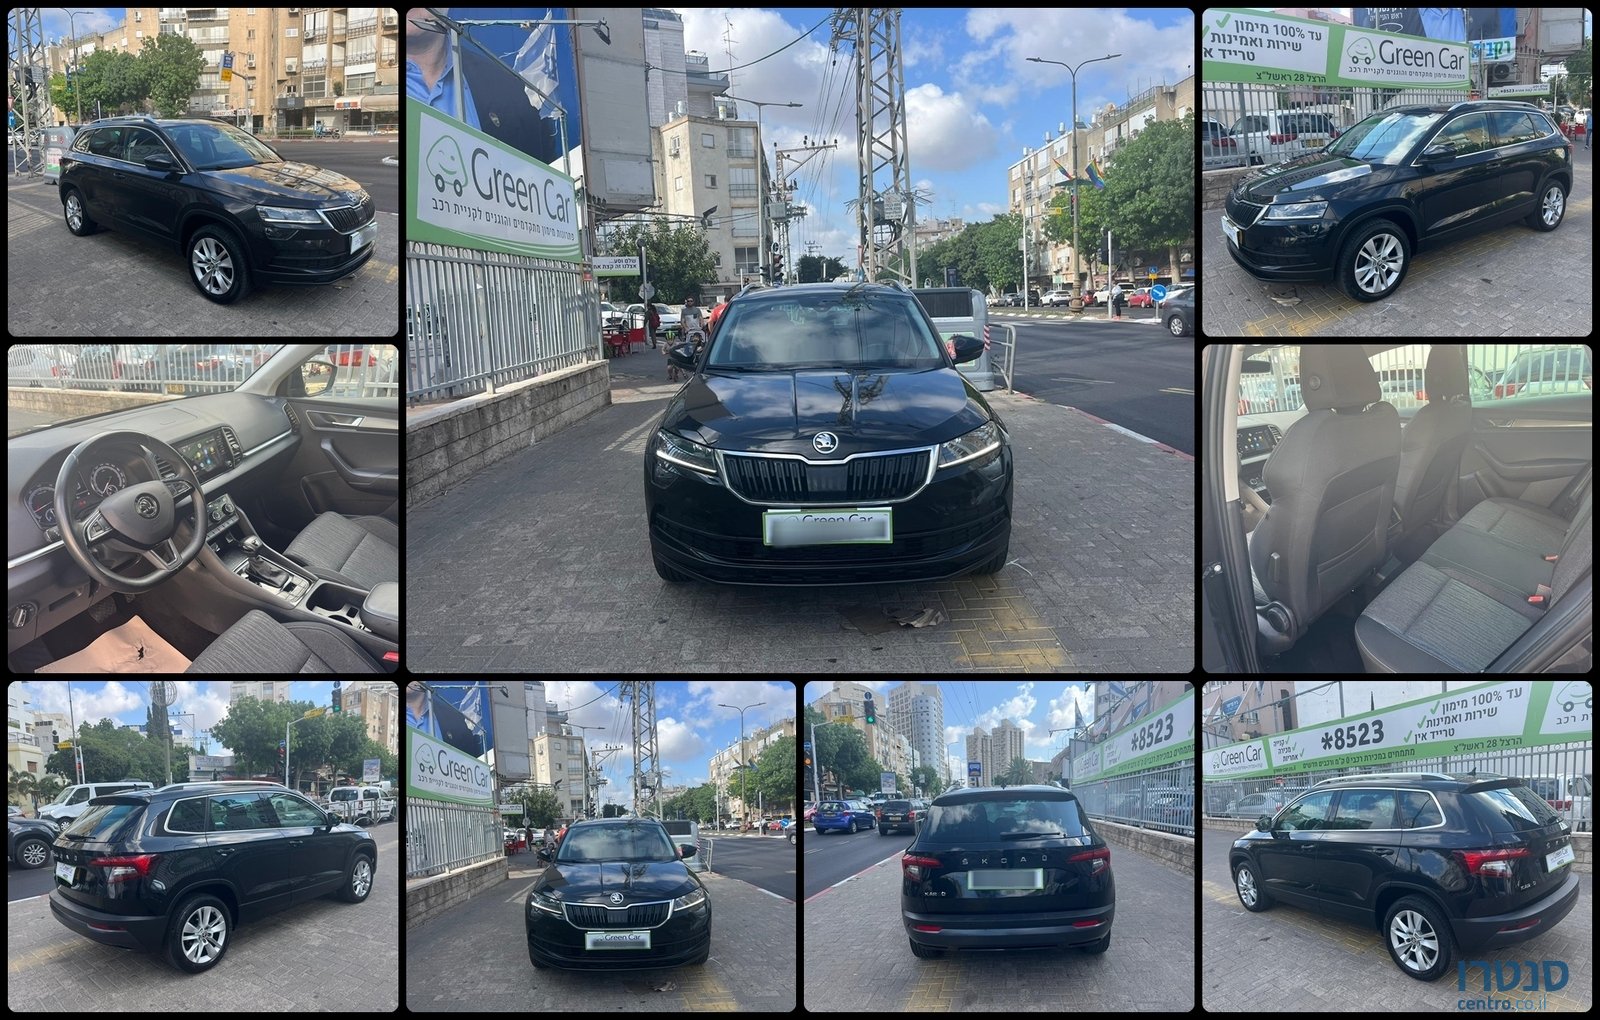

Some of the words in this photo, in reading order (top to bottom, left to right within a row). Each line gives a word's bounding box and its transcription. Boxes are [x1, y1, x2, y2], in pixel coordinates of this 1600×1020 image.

[1234, 20, 1269, 33] מימון
[1274, 24, 1305, 39] 100%
[1211, 32, 1262, 48] ואמינות
[1308, 30, 1322, 40] עד
[1267, 38, 1302, 52] שירות
[1218, 48, 1255, 61] טרייד
[1379, 40, 1434, 68] Green
[1438, 48, 1464, 70] Car
[1294, 73, 1304, 82] 28
[1364, 66, 1384, 75] לקניית
[1306, 74, 1326, 83] הרצל
[472, 148, 541, 215] Green
[544, 178, 570, 224] Car
[432, 197, 450, 213] רכב
[454, 203, 482, 222] לקניית
[485, 211, 512, 228] והוגנים
[513, 218, 540, 234] מתקדמים
[1472, 691, 1502, 706] 100%
[1506, 687, 1522, 698] עד
[1442, 696, 1468, 715] מימון
[1426, 713, 1461, 728] ואמינות
[1464, 706, 1498, 721] שירות
[1556, 715, 1576, 724] רכב
[1414, 730, 1428, 744] אין
[1430, 727, 1454, 742] טרייד
[1500, 737, 1522, 746] הרצל
[1486, 738, 1498, 748] 28
[1221, 750, 1244, 766] Green
[1246, 745, 1262, 762] Car
[1364, 752, 1386, 762] במכירת
[1388, 748, 1416, 758] מתמחים
[438, 750, 473, 784] Green
[475, 766, 488, 788] Car
[418, 774, 428, 782] רכב
